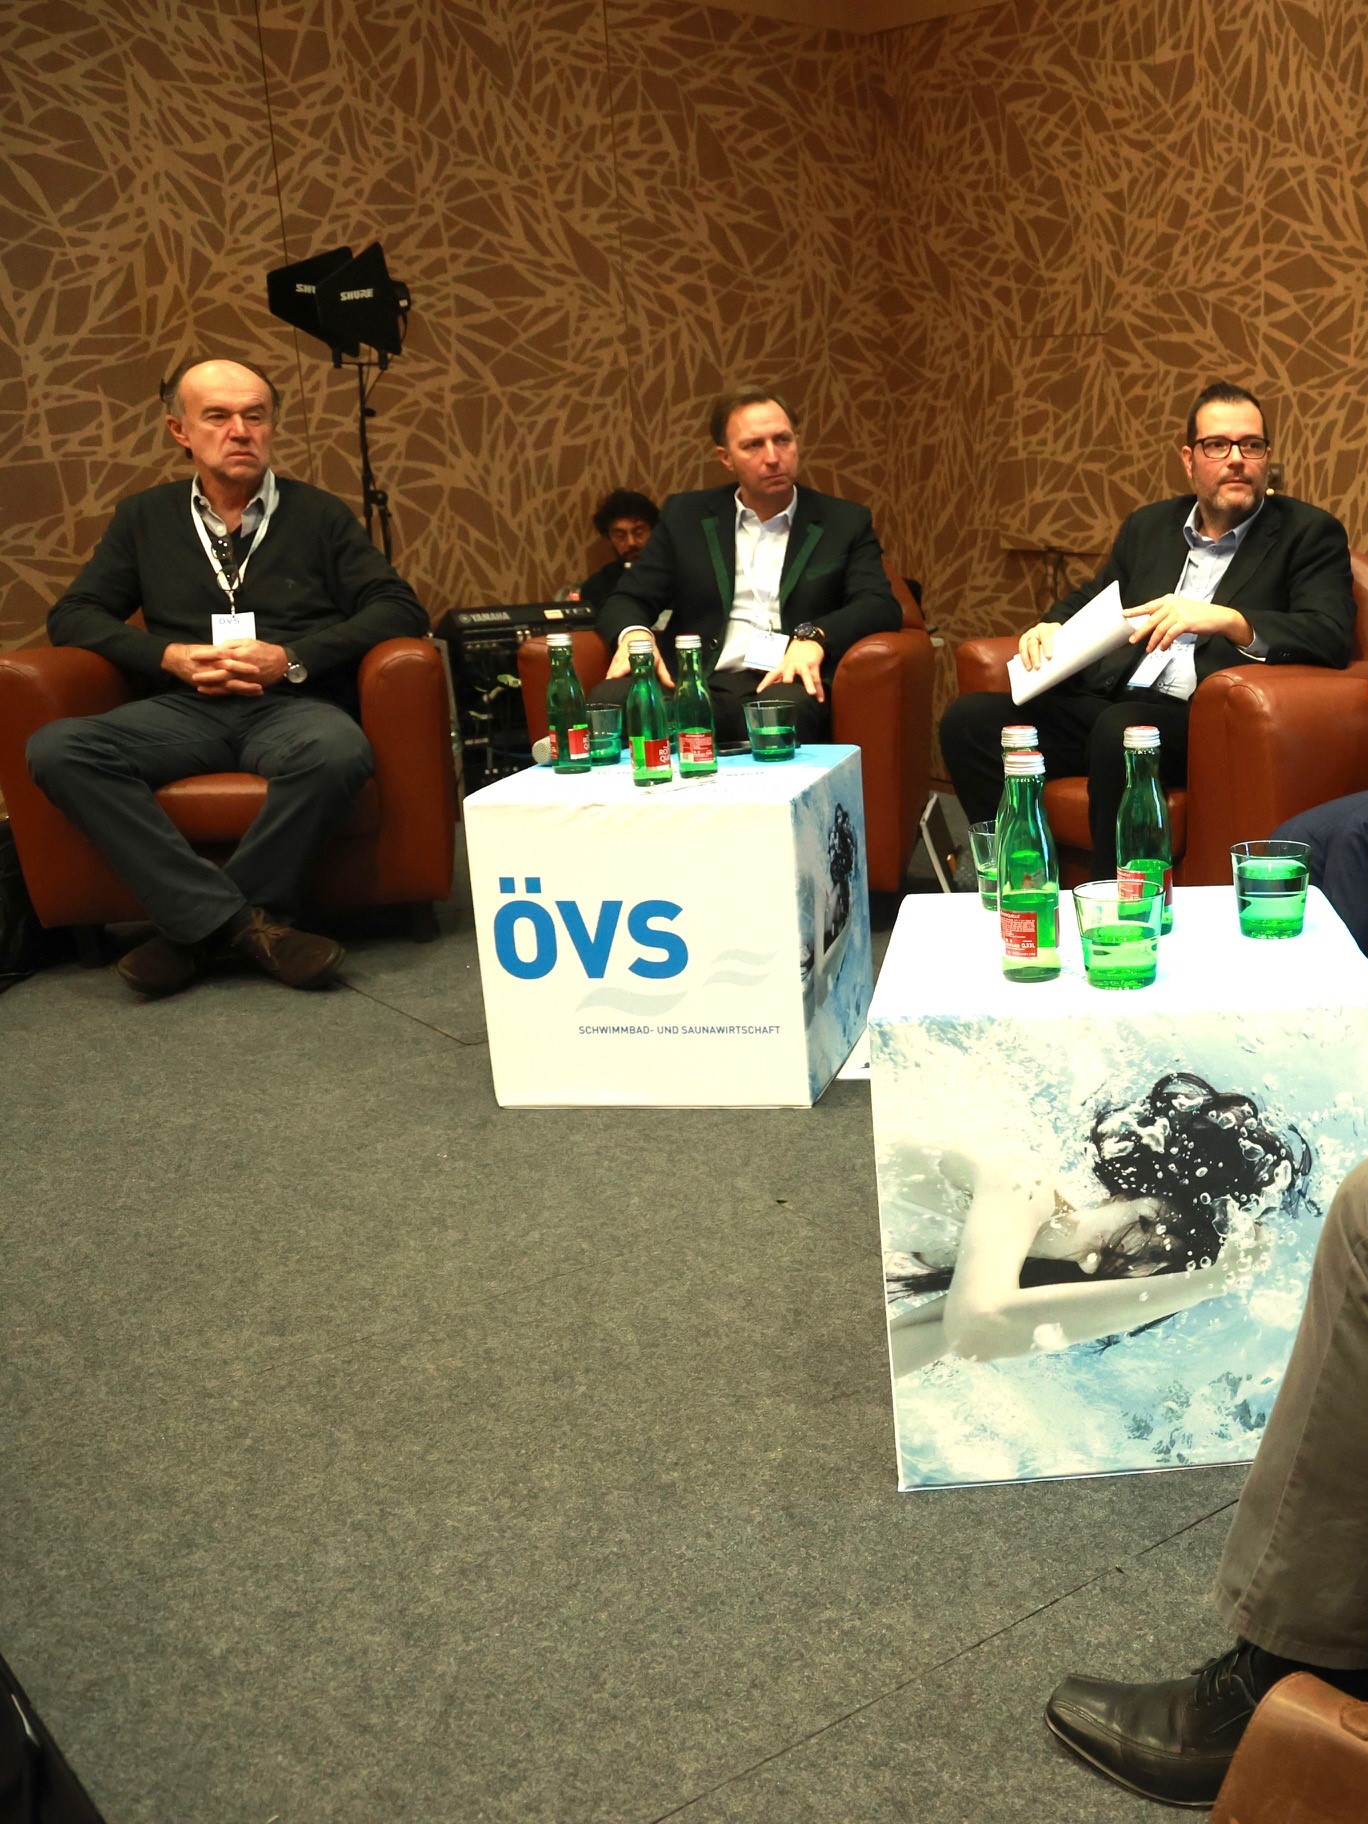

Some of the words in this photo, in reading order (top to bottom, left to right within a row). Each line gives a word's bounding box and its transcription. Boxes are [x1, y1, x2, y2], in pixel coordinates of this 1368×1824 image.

[340, 288, 374, 301] SHURE
[470, 611, 511, 622] YAMAHA
[494, 877, 689, 980] ÖVS
[579, 1025, 654, 1035] SCHWIMMBAD-
[657, 1025, 679, 1035] UND
[681, 1025, 781, 1035] SAUNAWIRTSCHAFT
